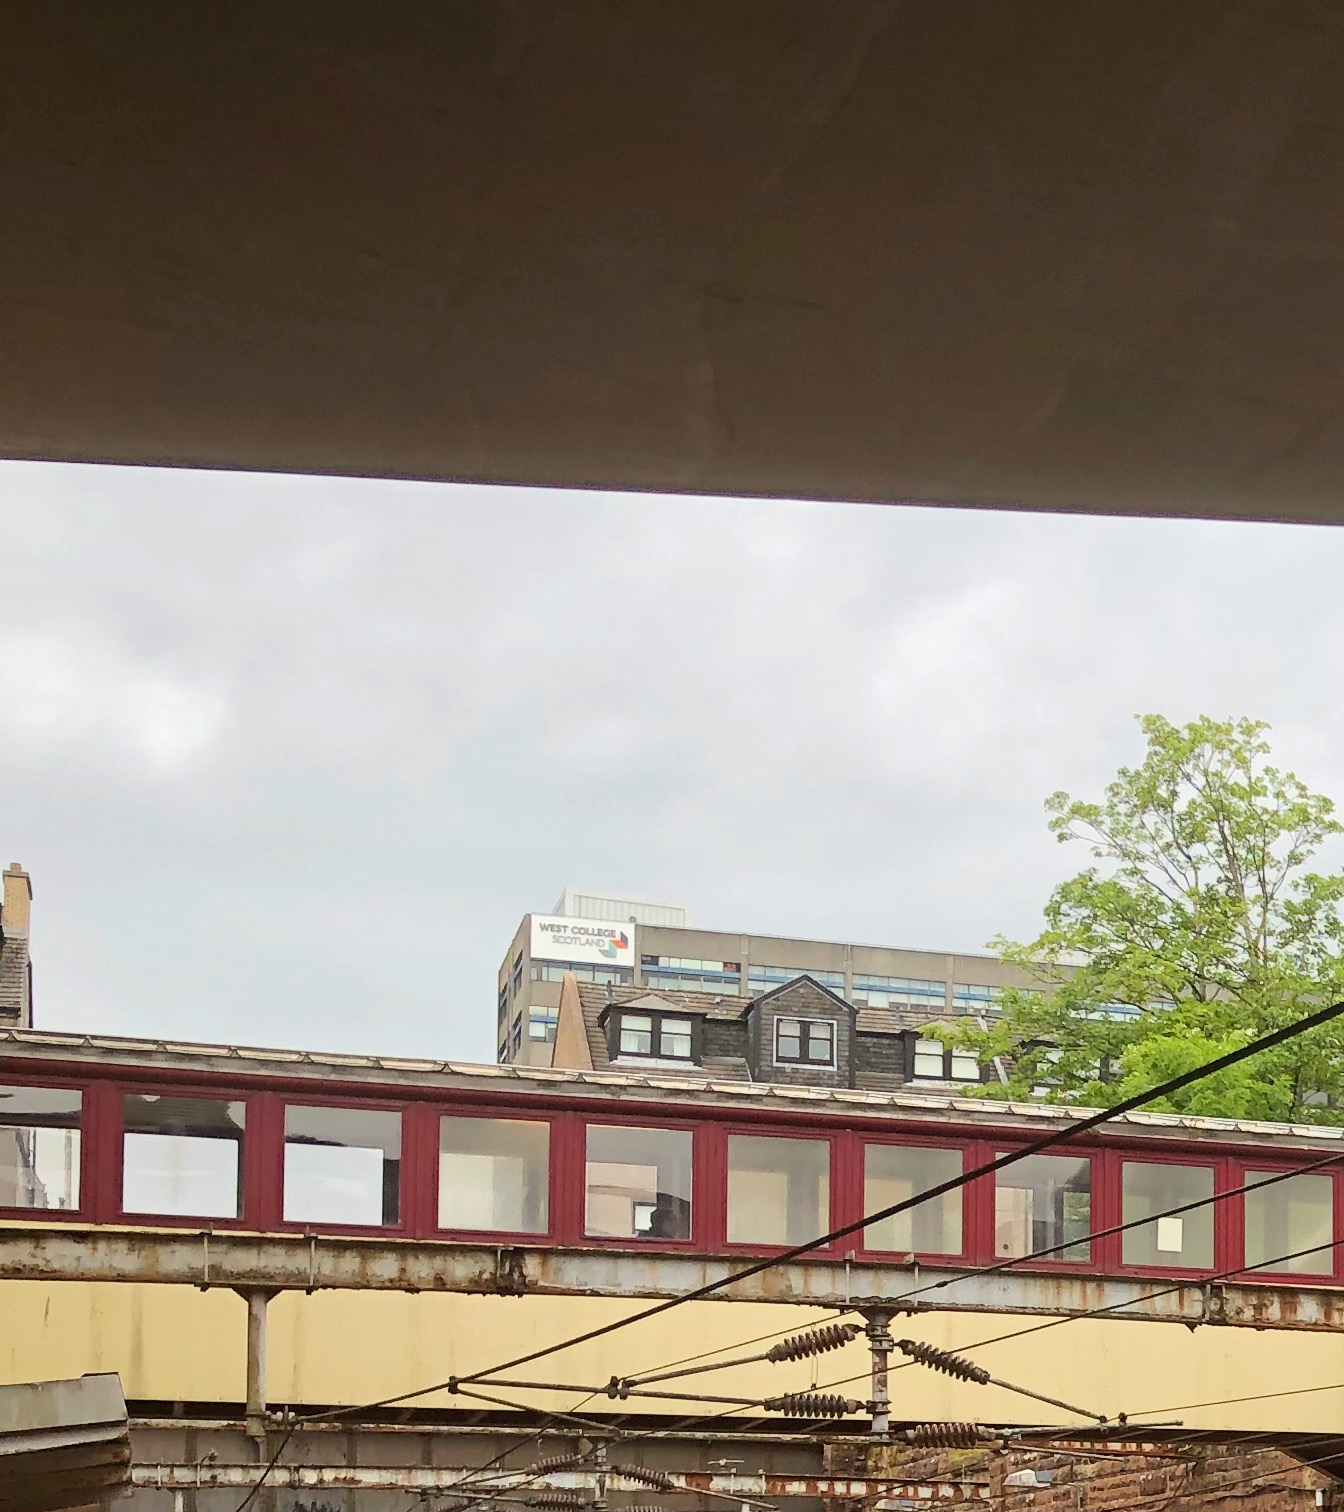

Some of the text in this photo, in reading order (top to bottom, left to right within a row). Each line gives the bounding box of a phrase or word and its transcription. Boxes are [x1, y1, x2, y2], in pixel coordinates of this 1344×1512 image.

[539, 922, 617, 938] WEST COLLEGE
[551, 935, 606, 948] SCOTLAND
